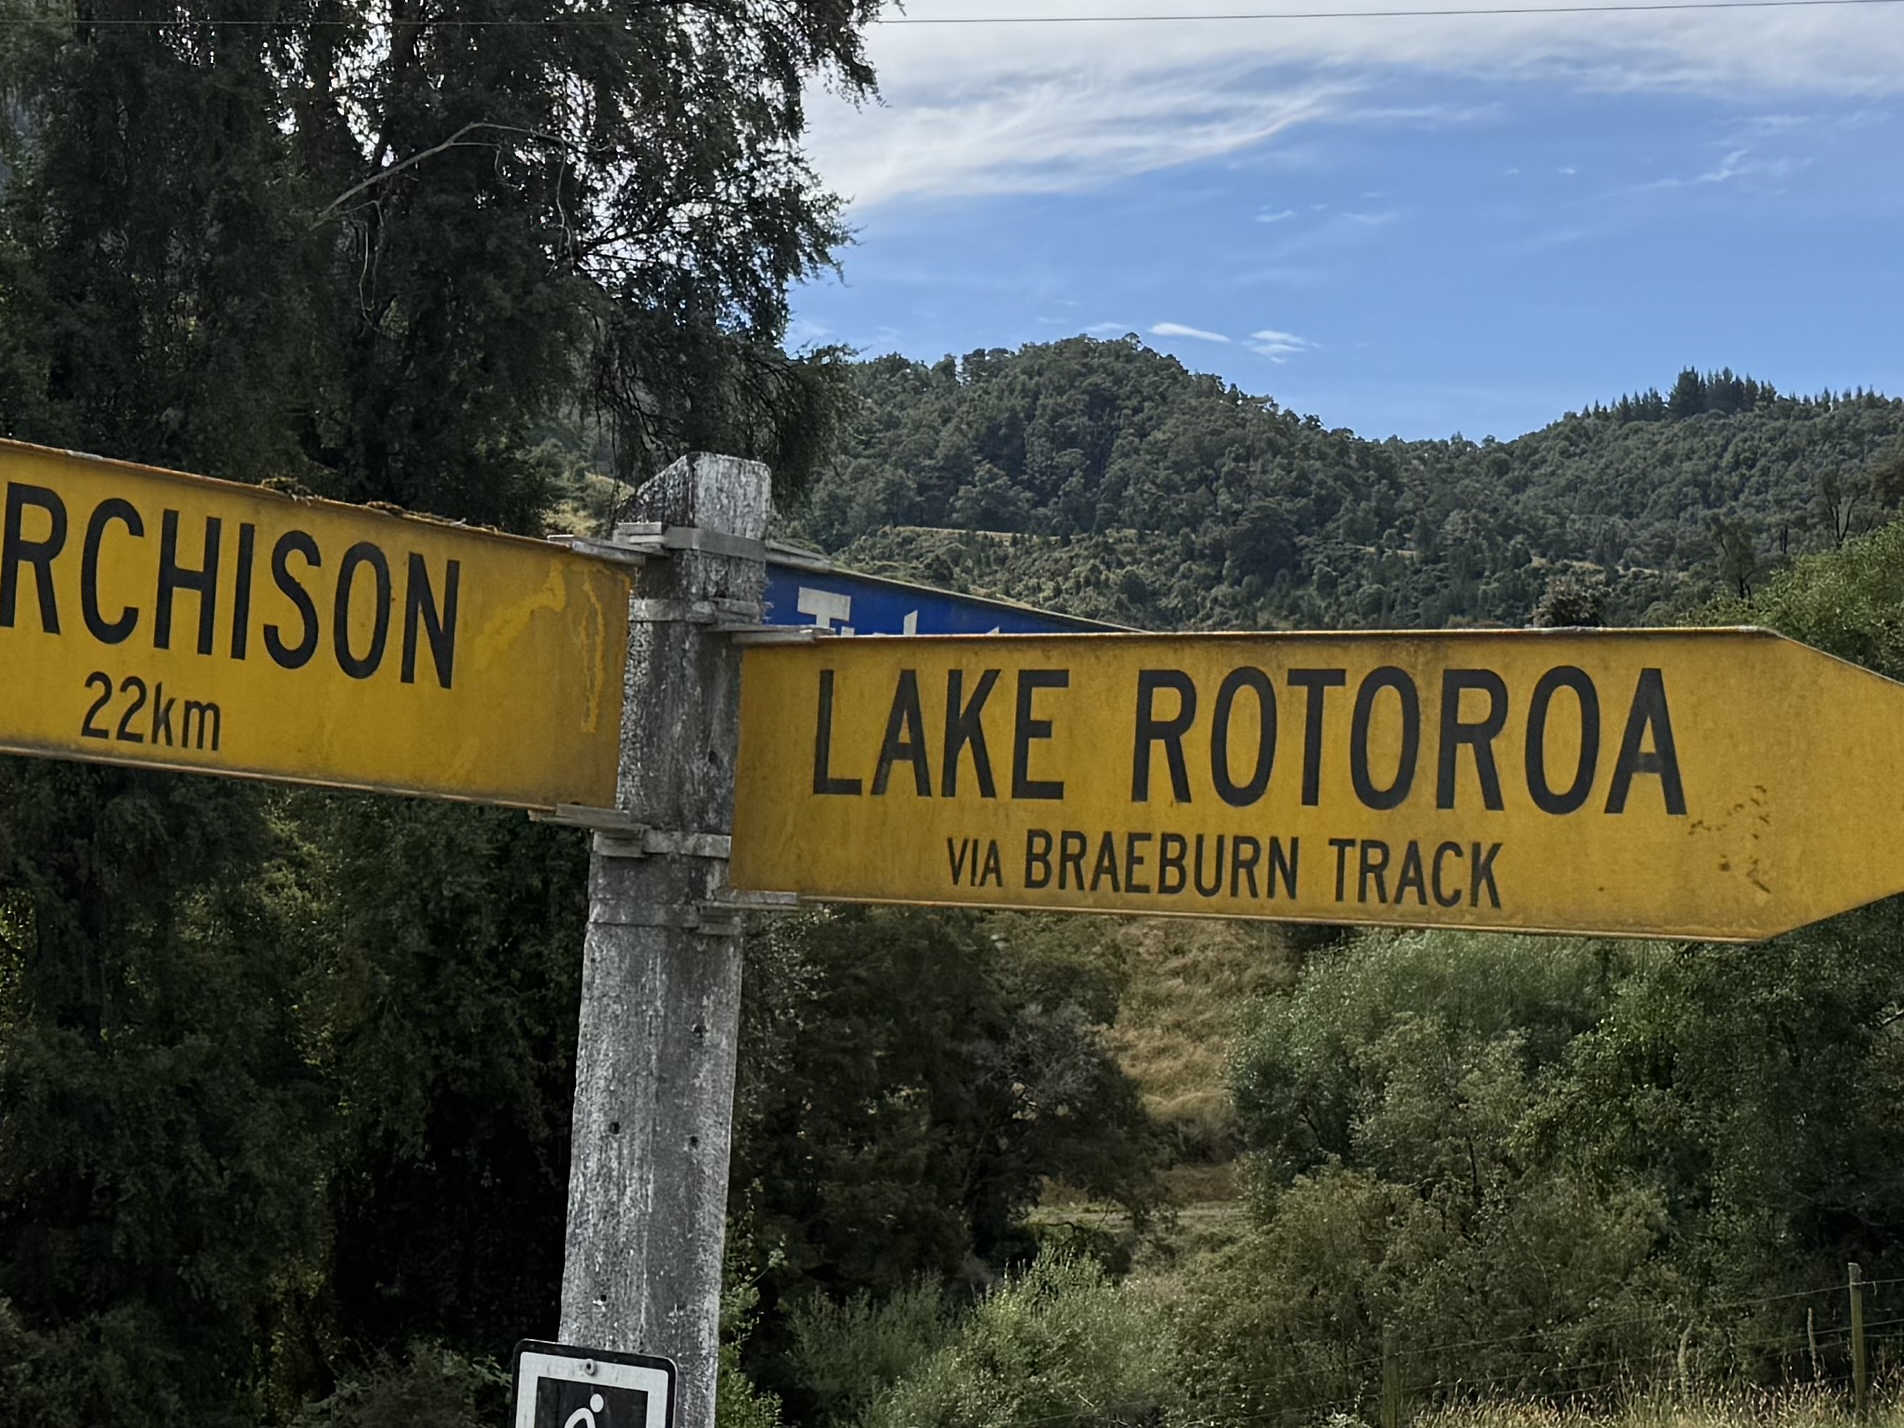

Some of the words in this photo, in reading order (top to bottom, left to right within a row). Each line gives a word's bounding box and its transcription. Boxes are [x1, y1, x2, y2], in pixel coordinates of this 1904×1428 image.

[81, 670, 222, 752] 22km
[812, 667, 1071, 801] LAKE
[1130, 664, 1689, 817] ROTOROA
[947, 836, 1002, 890] VIA
[1024, 829, 1300, 902] BRAEBURN
[1328, 837, 1504, 911] TRACK
